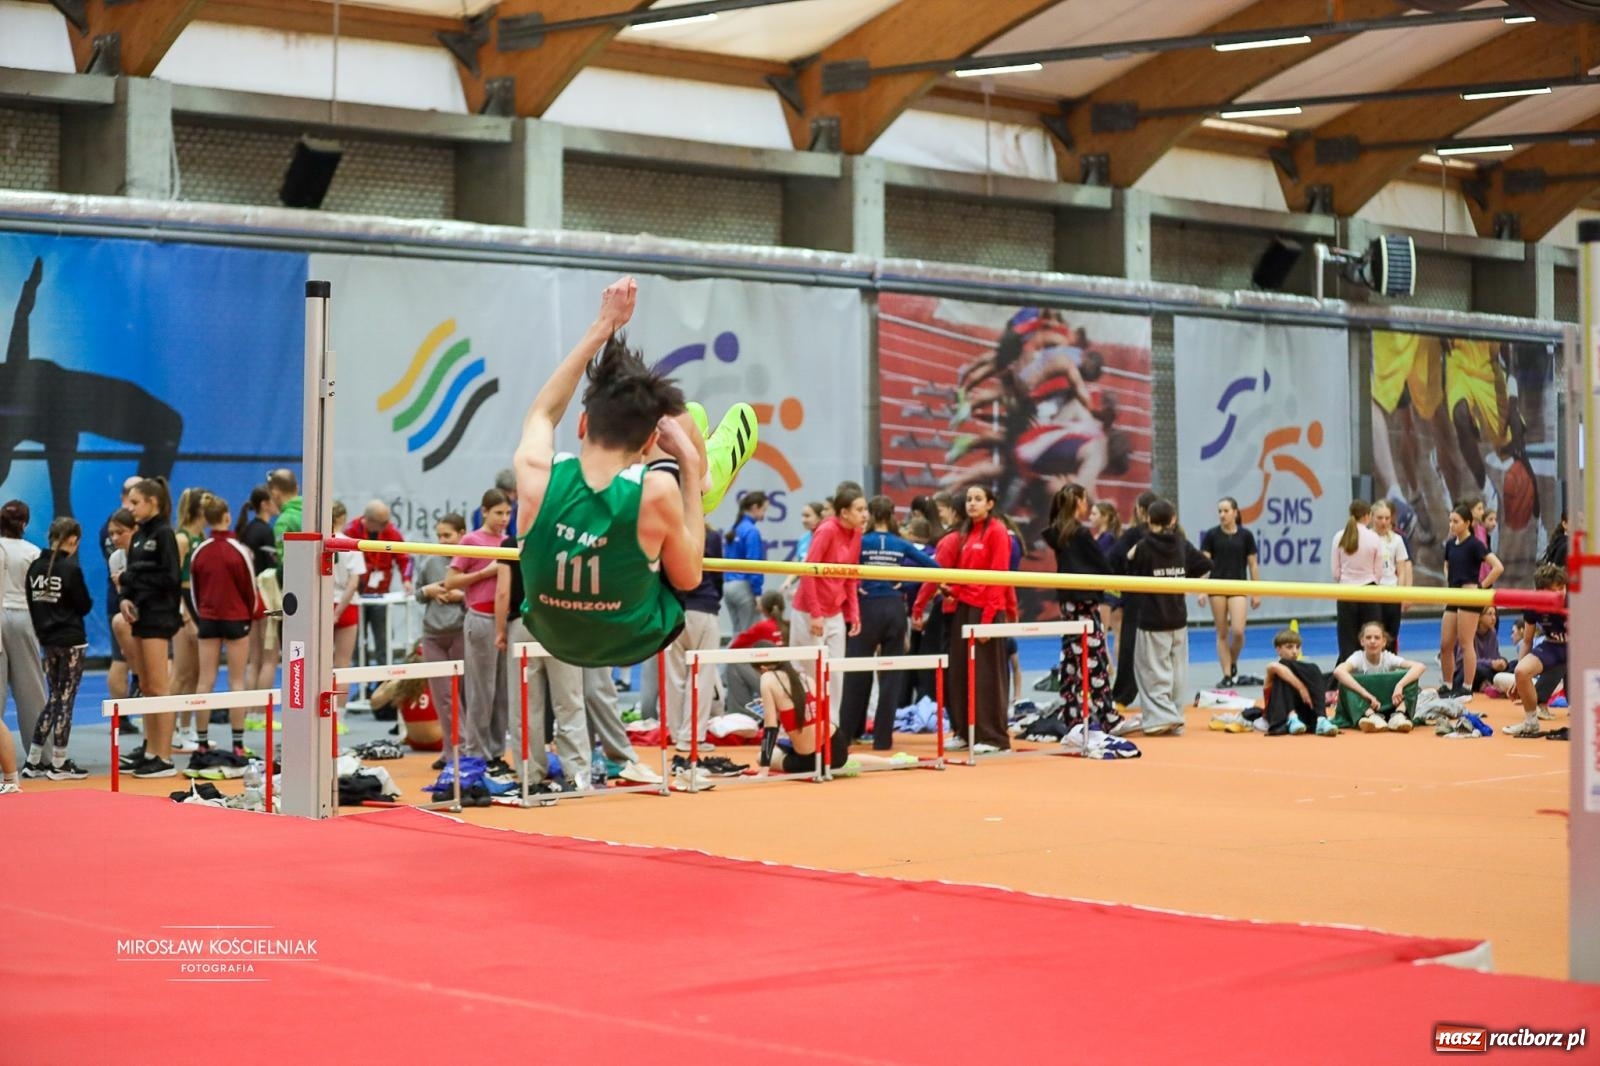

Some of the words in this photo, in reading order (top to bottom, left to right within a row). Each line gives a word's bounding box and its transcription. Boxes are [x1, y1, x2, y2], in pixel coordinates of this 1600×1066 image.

[1267, 497, 1313, 525] SMS
[556, 522, 576, 541] TS
[556, 550, 600, 595] 111
[293, 663, 302, 706] polanik
